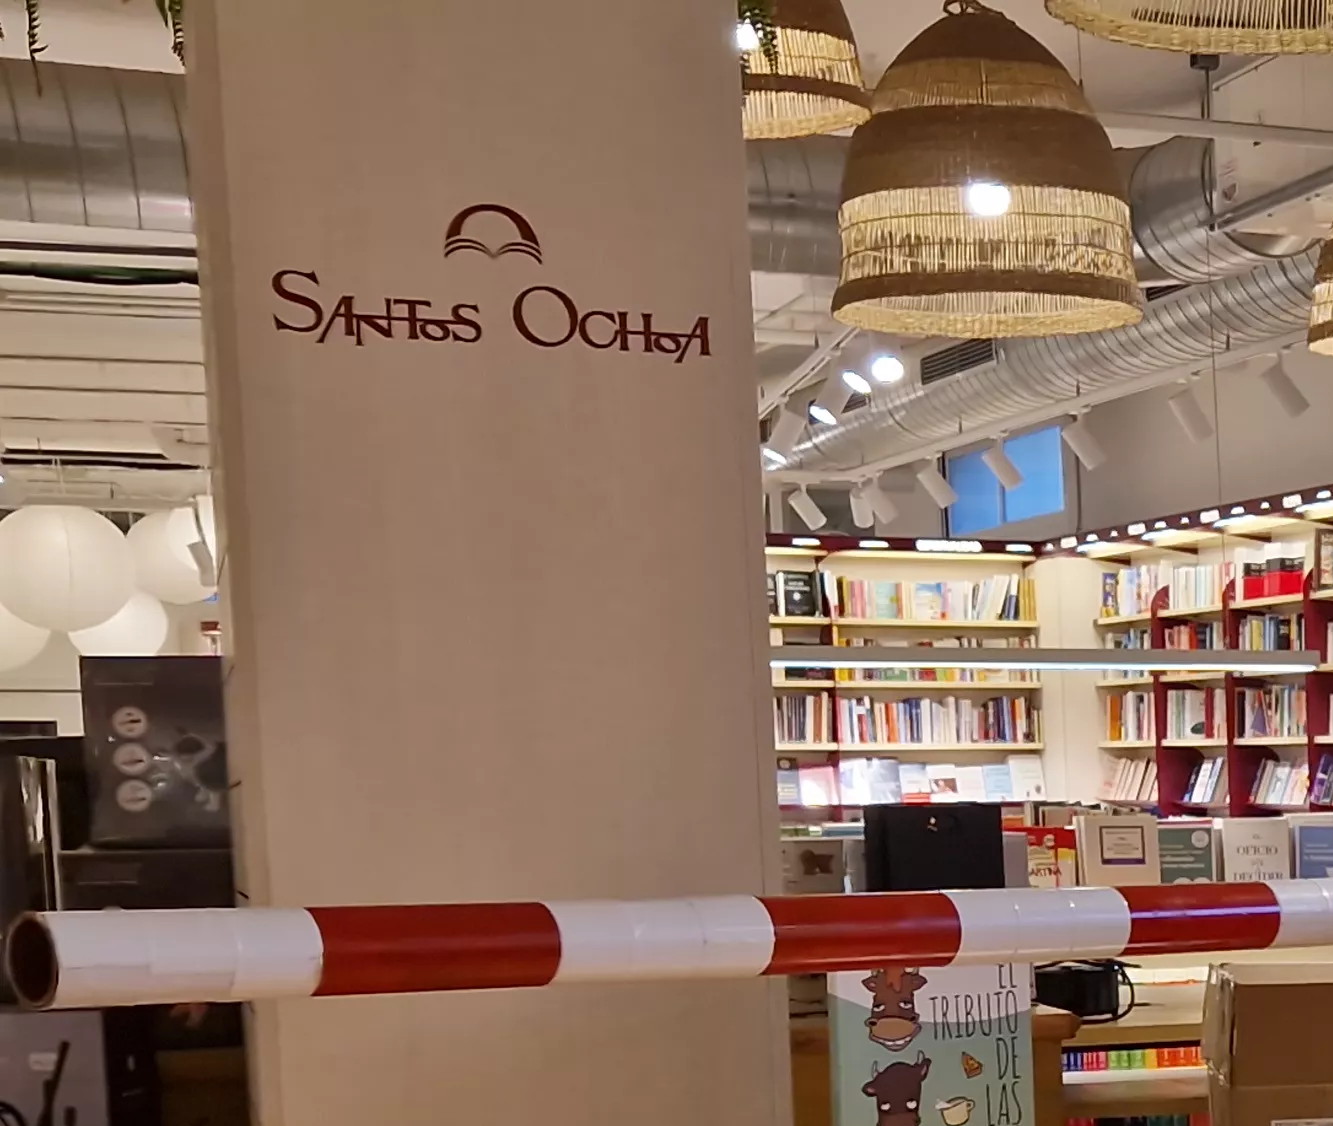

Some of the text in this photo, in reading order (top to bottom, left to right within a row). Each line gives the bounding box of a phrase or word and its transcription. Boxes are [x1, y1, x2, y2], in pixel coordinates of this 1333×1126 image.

[1236, 844, 1279, 856] OFICIO
[1028, 866, 1063, 877] ARTINA
[996, 962, 1017, 990] EL
[929, 990, 1020, 1041] TRIBUTO
[995, 1035, 1022, 1081] DE
